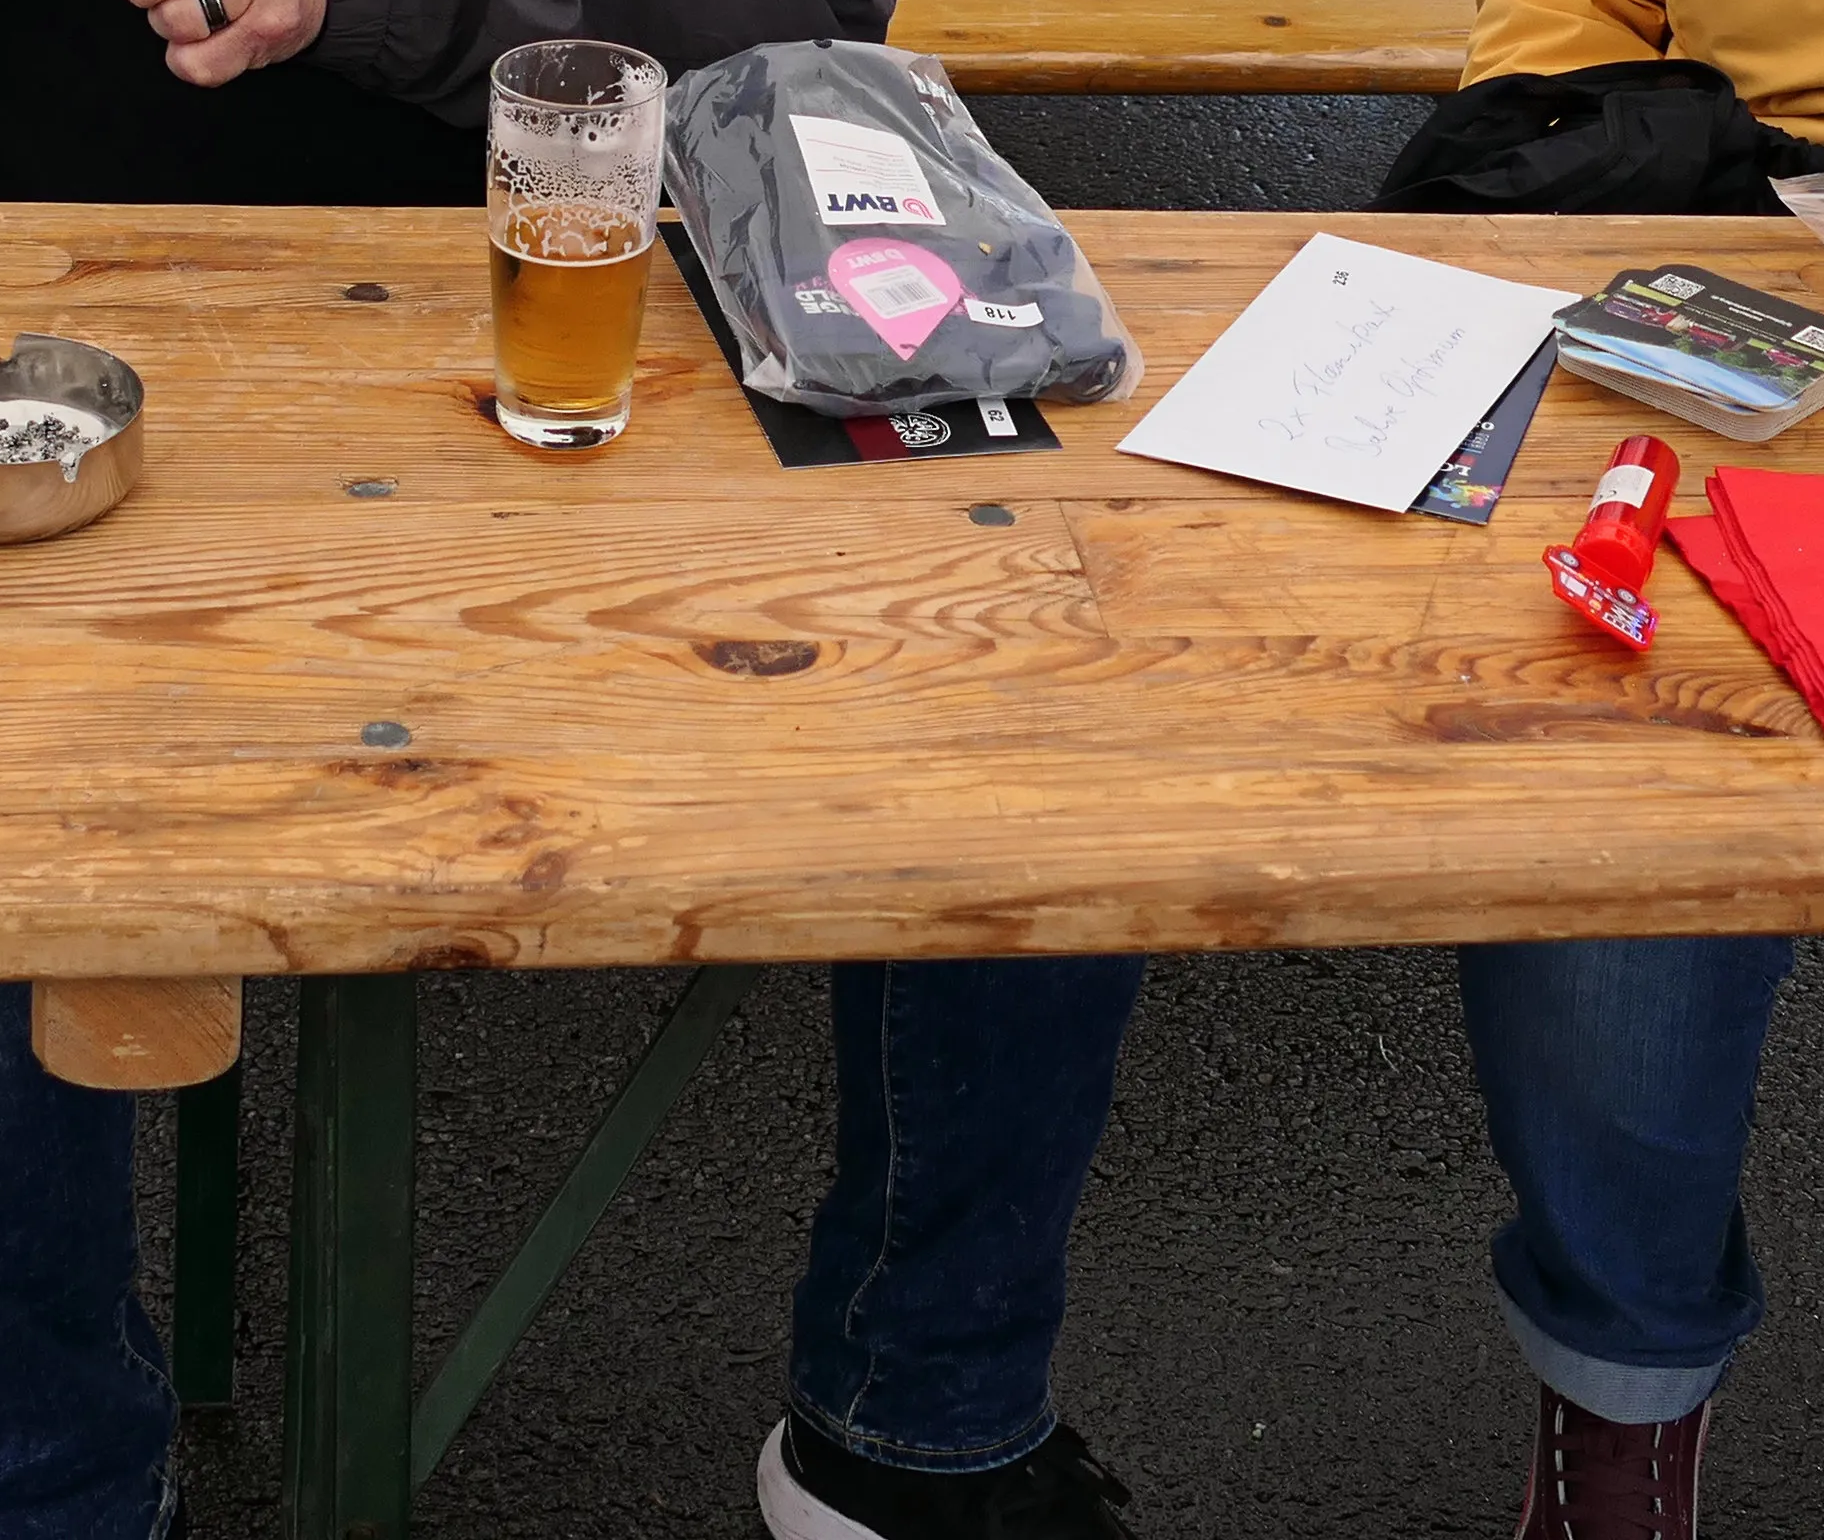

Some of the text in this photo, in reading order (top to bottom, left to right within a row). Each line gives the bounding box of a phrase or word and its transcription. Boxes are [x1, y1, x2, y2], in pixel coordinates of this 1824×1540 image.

[827, 192, 900, 214] BWT
[985, 306, 1016, 322] 118
[988, 409, 1003, 424] 62
